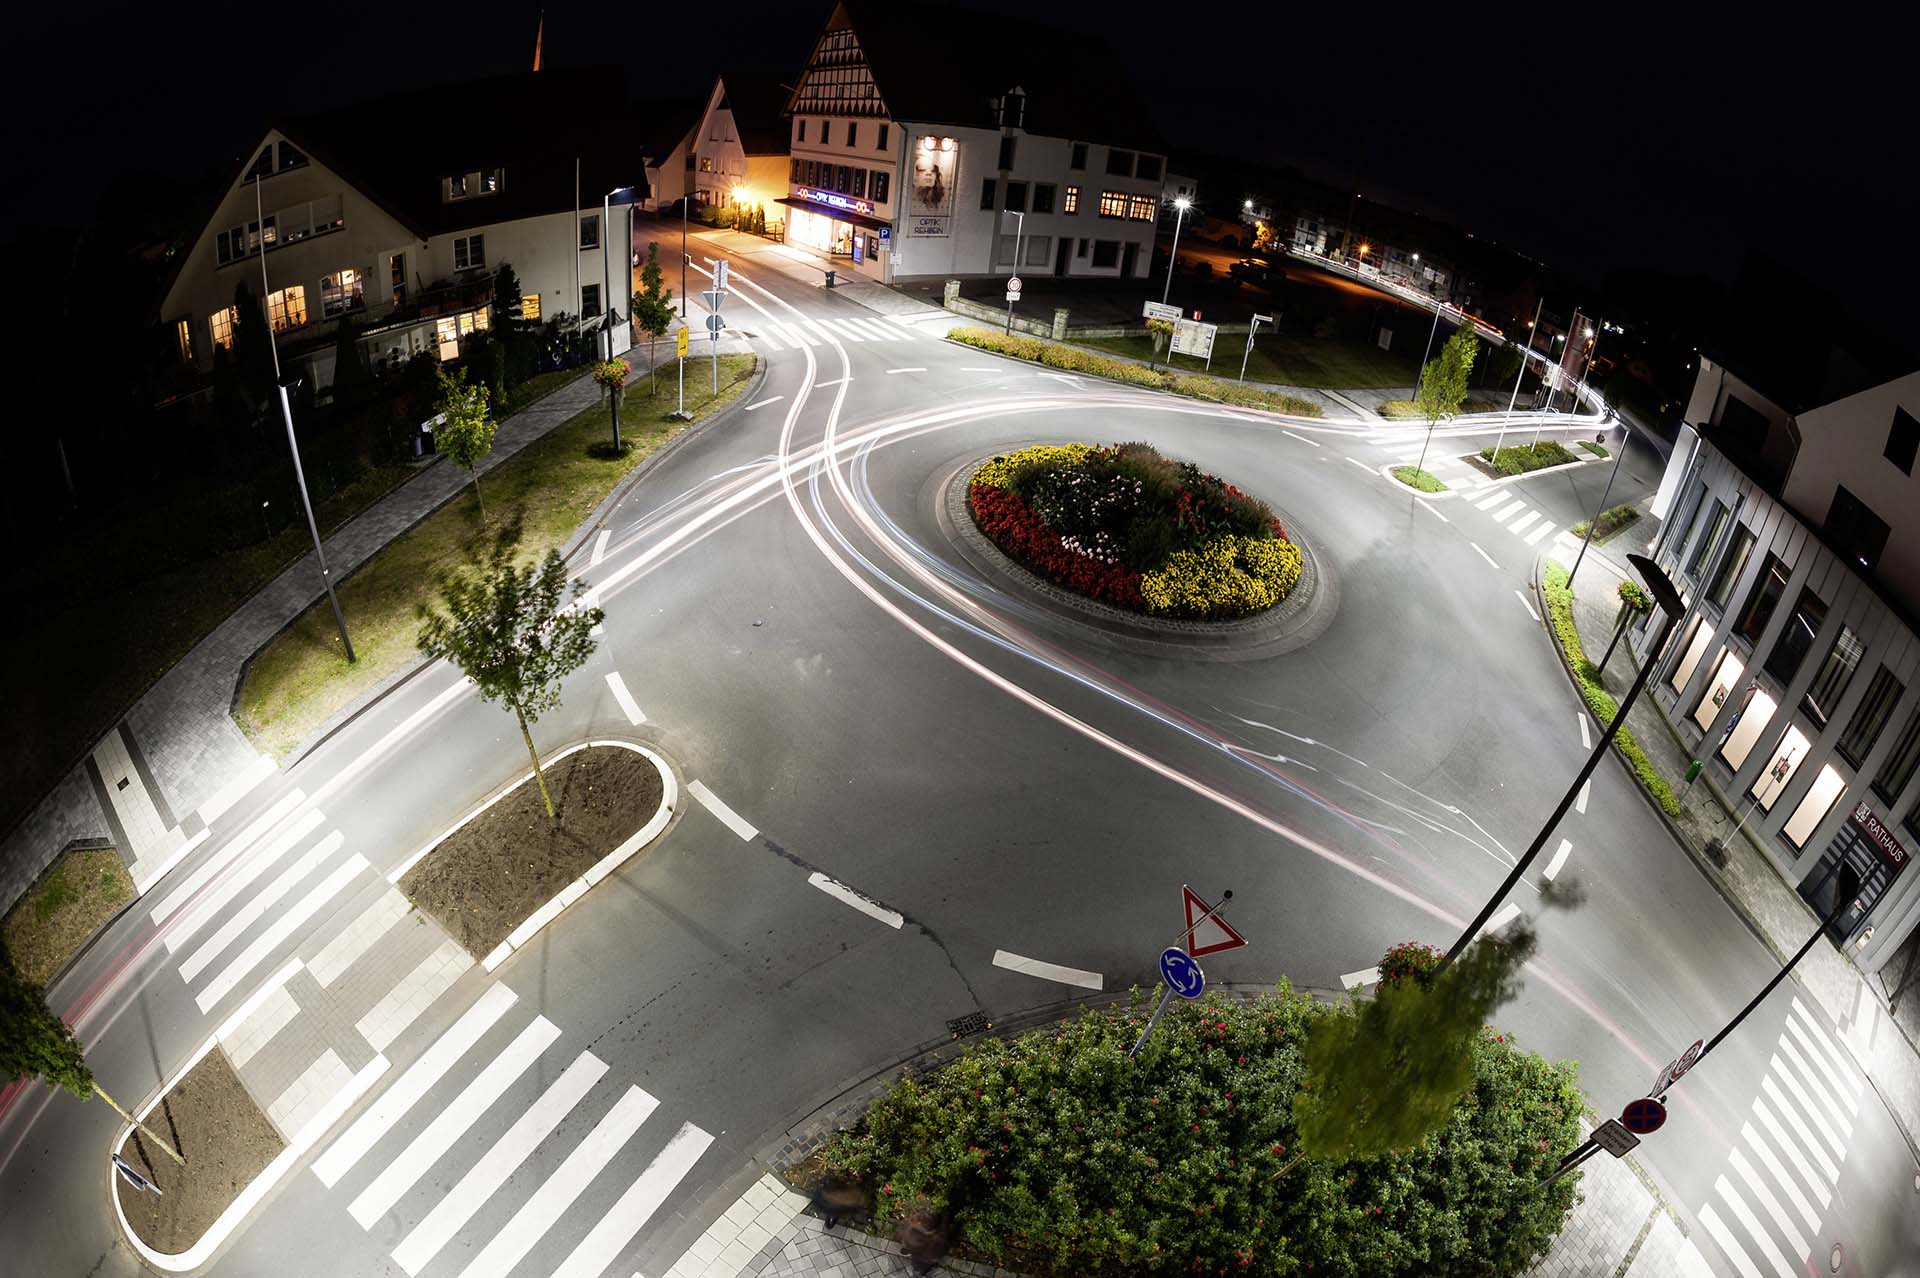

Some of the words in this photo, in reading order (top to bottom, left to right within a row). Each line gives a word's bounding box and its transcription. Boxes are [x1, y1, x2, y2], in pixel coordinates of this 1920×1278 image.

[919, 218, 941, 226] OPTIK
[881, 229, 889, 238] P
[1867, 817, 1904, 862] RATHAUS
